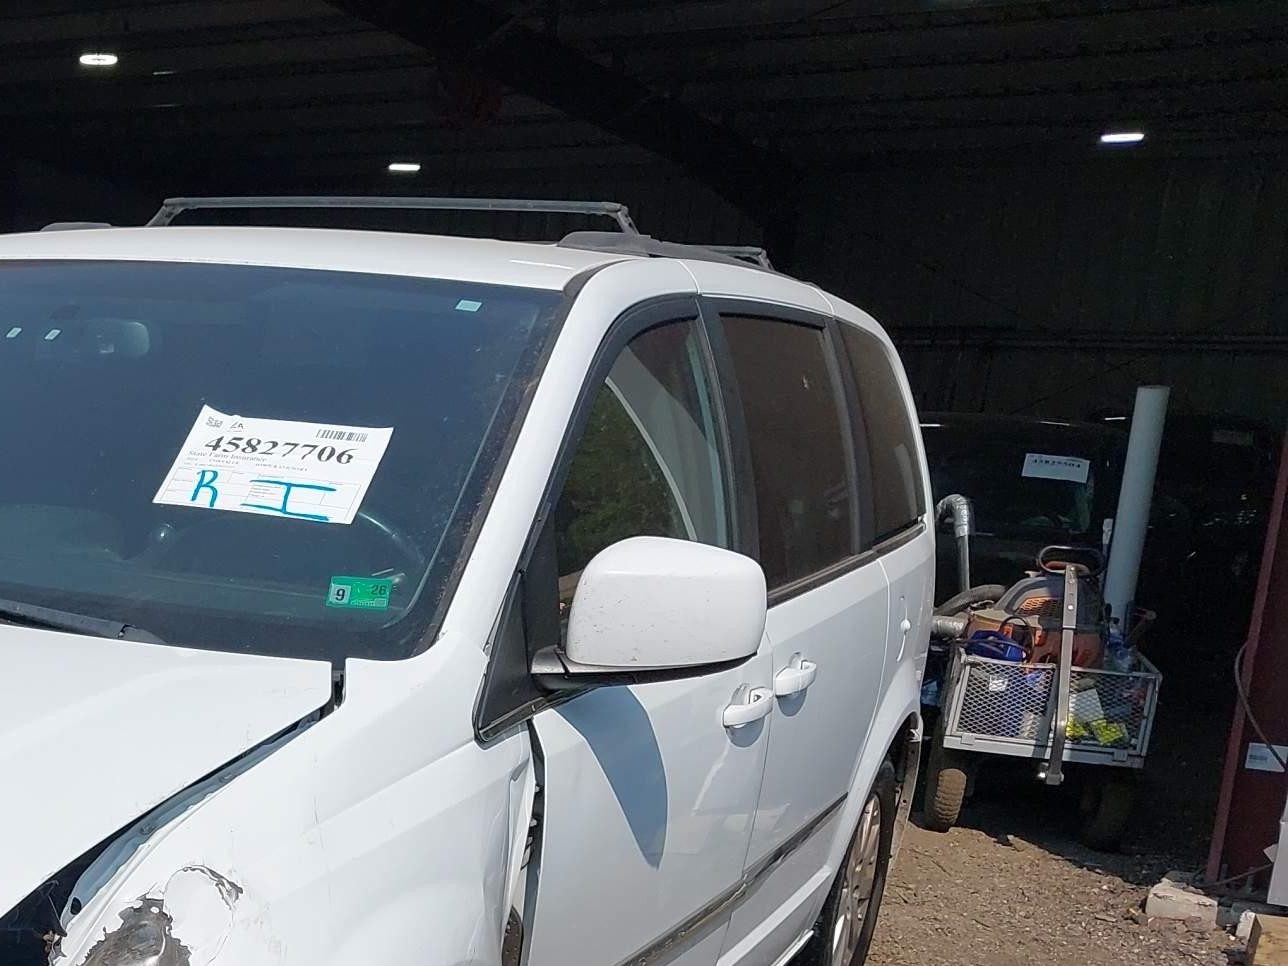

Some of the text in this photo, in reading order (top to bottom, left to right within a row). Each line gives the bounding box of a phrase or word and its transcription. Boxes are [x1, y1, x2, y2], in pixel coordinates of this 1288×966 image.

[205, 435, 359, 465] 45827706
[191, 469, 219, 508] R
[335, 584, 388, 601] 9 26
